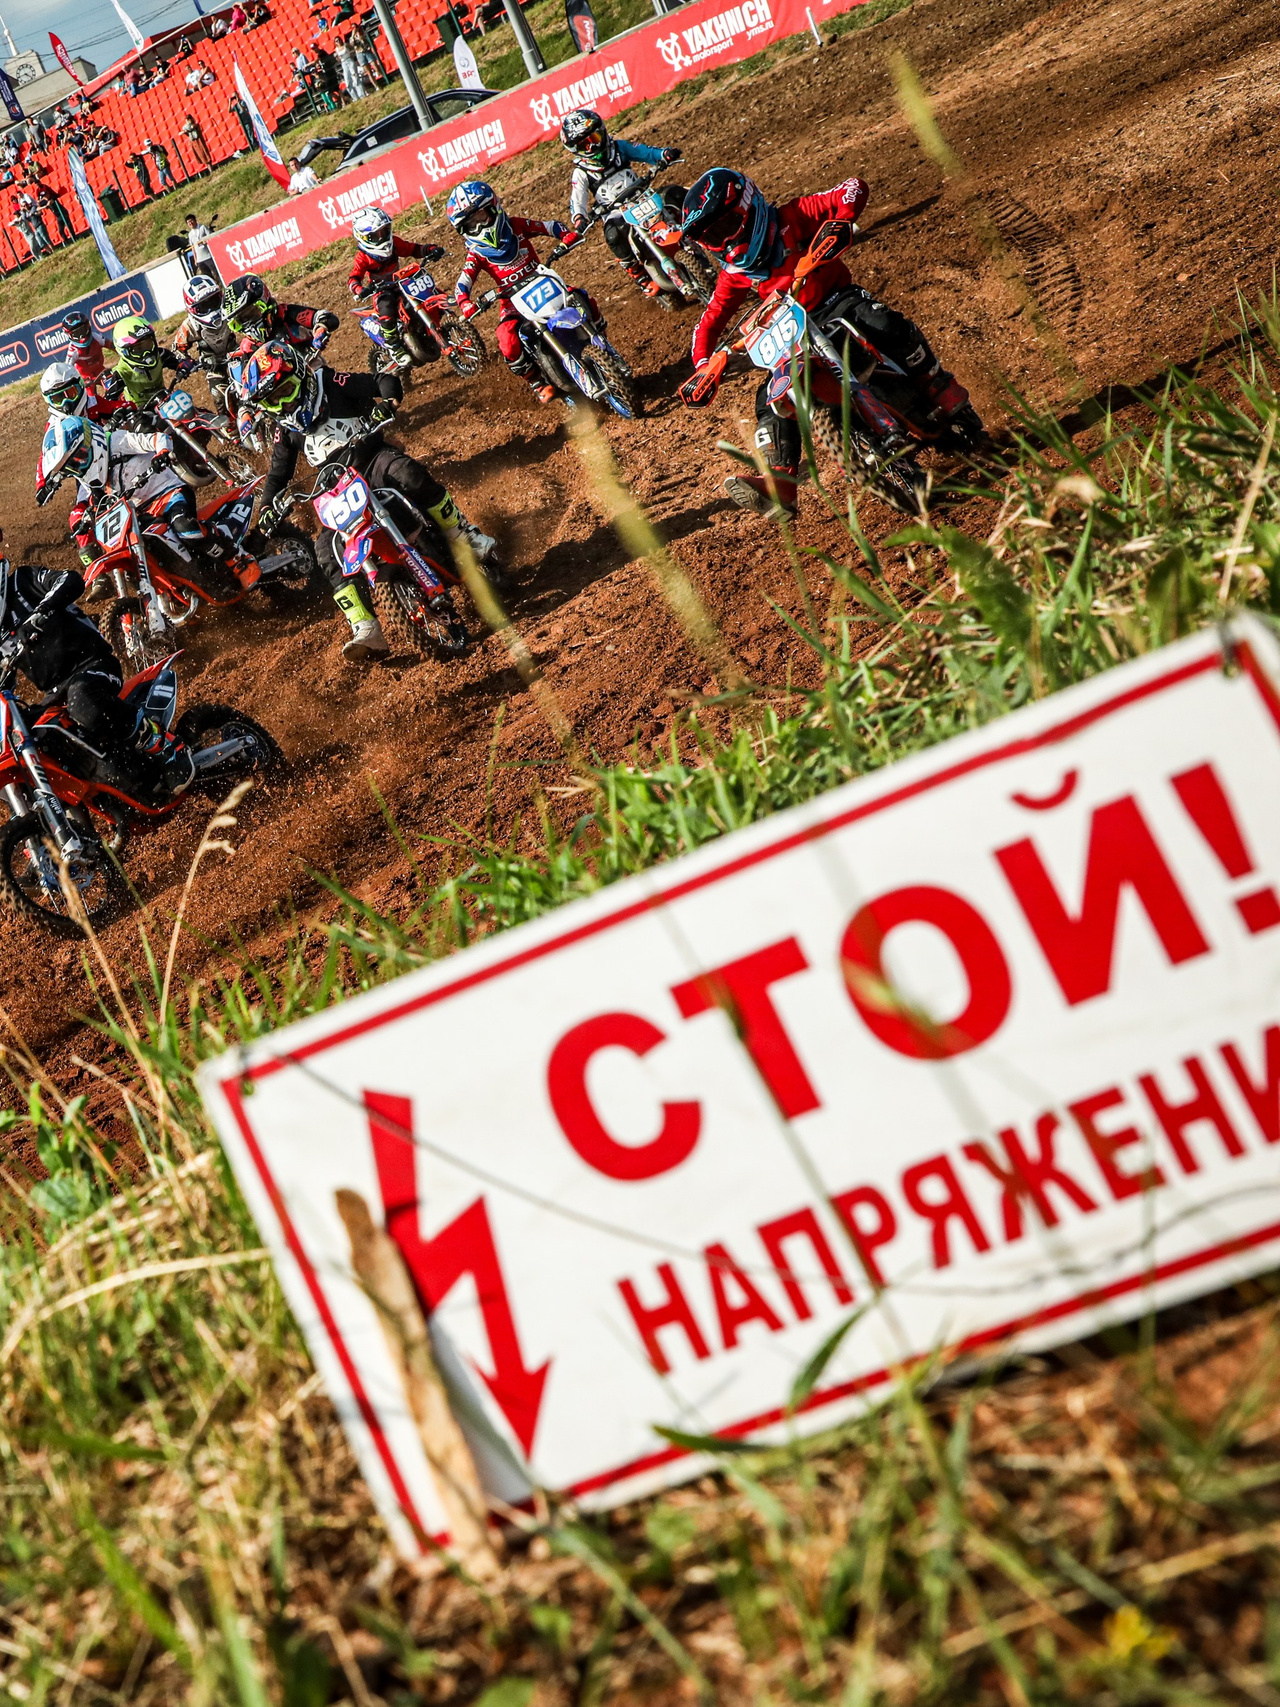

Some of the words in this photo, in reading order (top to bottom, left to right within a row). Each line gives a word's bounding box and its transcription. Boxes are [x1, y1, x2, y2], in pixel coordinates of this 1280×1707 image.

[681, 0, 772, 54] YAKHNICH
[746, 20, 775, 40] yms.ru
[692, 38, 734, 64] motorsport
[552, 61, 629, 112] YAKHNICH
[608, 84, 632, 103] yms.ru
[437, 119, 505, 166] YAKHNICH
[486, 142, 507, 159] yms.ru
[447, 154, 478, 175] motorsport
[336, 170, 398, 215] YAKHNICH
[243, 216, 301, 259] YAKHNICH
[410, 274, 434, 296] 589
[526, 282, 556, 310] 173
[94, 302, 132, 329] Winline
[37, 330, 69, 352] Winlin
[759, 310, 799, 365] 815
[162, 391, 193, 420] 28
[229, 504, 251, 523] 12
[322, 481, 367, 528] 150
[102, 513, 121, 543] 12
[547, 761, 1280, 1181] СТОЙ!
